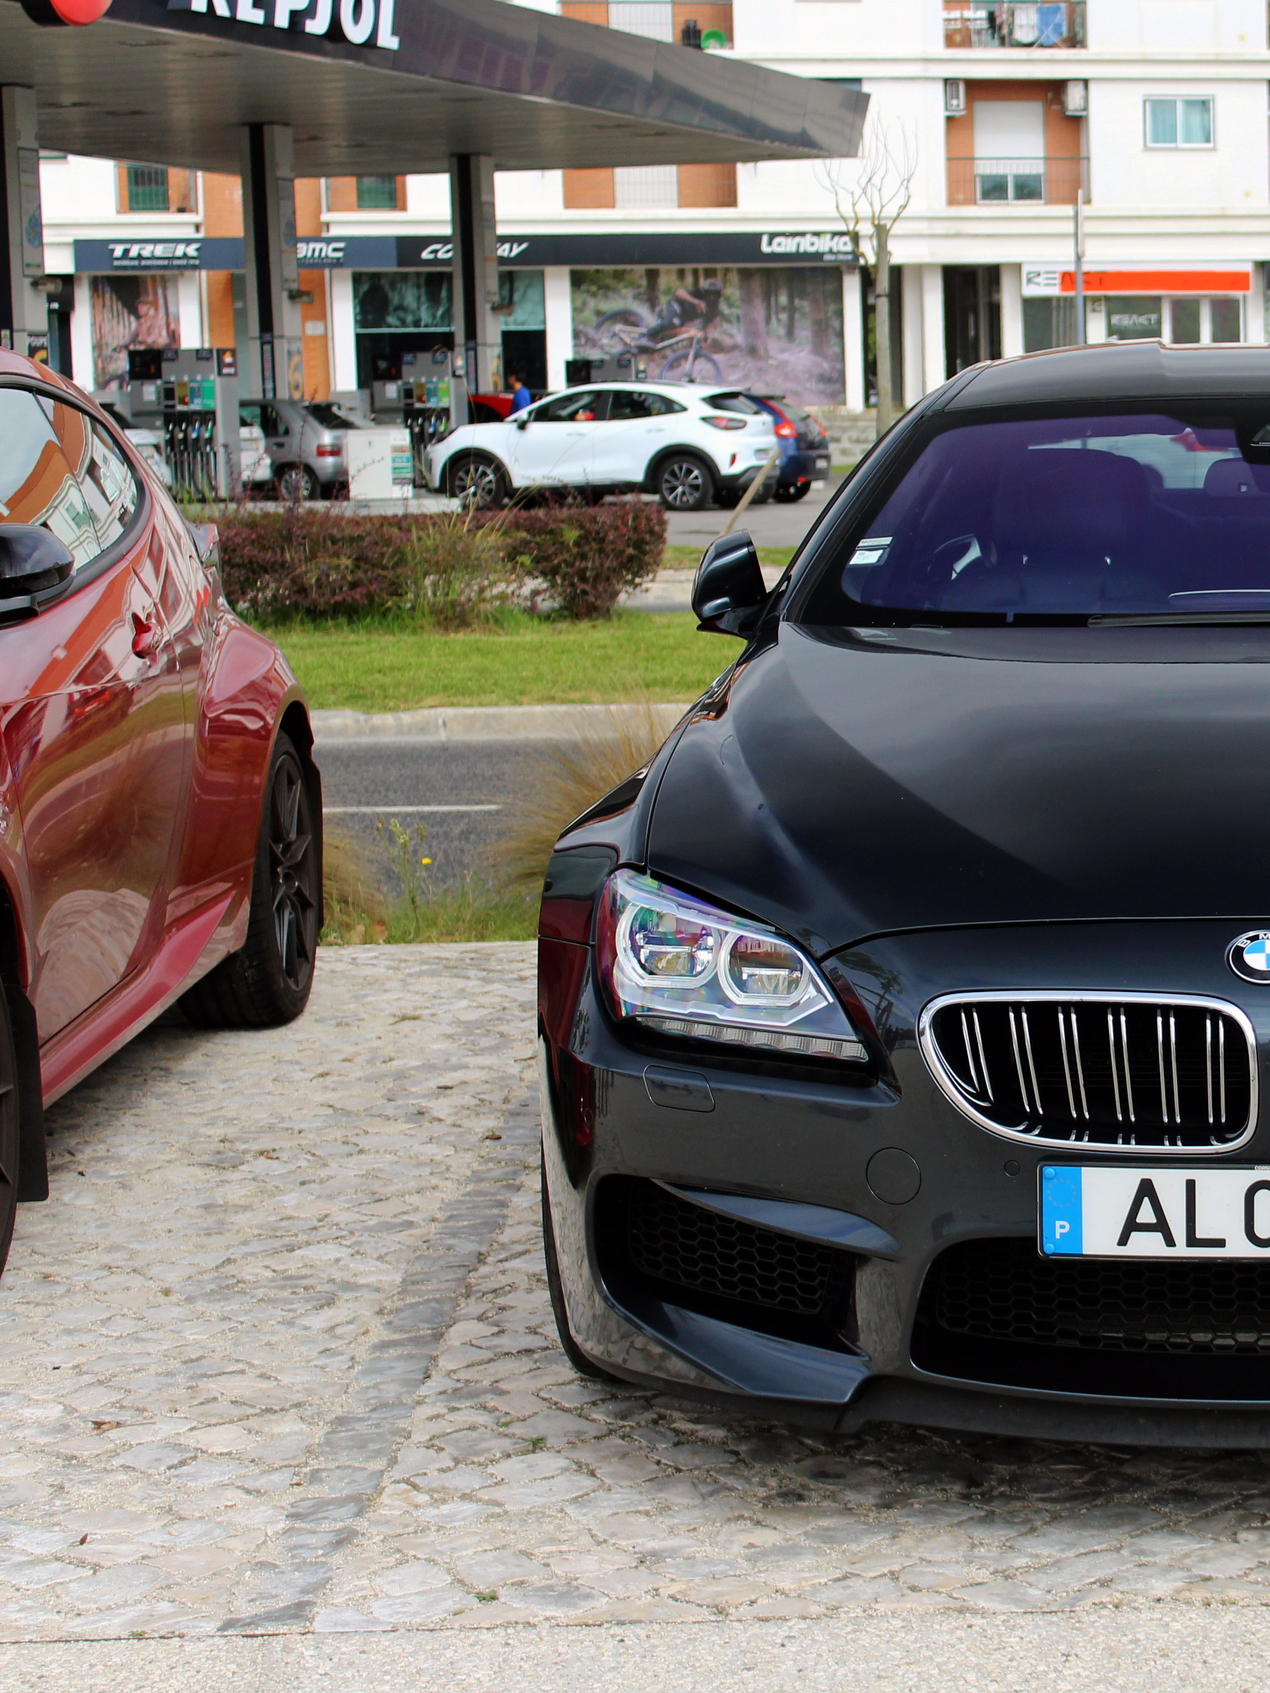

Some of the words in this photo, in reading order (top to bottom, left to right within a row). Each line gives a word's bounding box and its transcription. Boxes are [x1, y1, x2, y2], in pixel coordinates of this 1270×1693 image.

[107, 243, 202, 258] TREK
[420, 242, 530, 260] COAY
[1054, 1221, 1071, 1240] P
